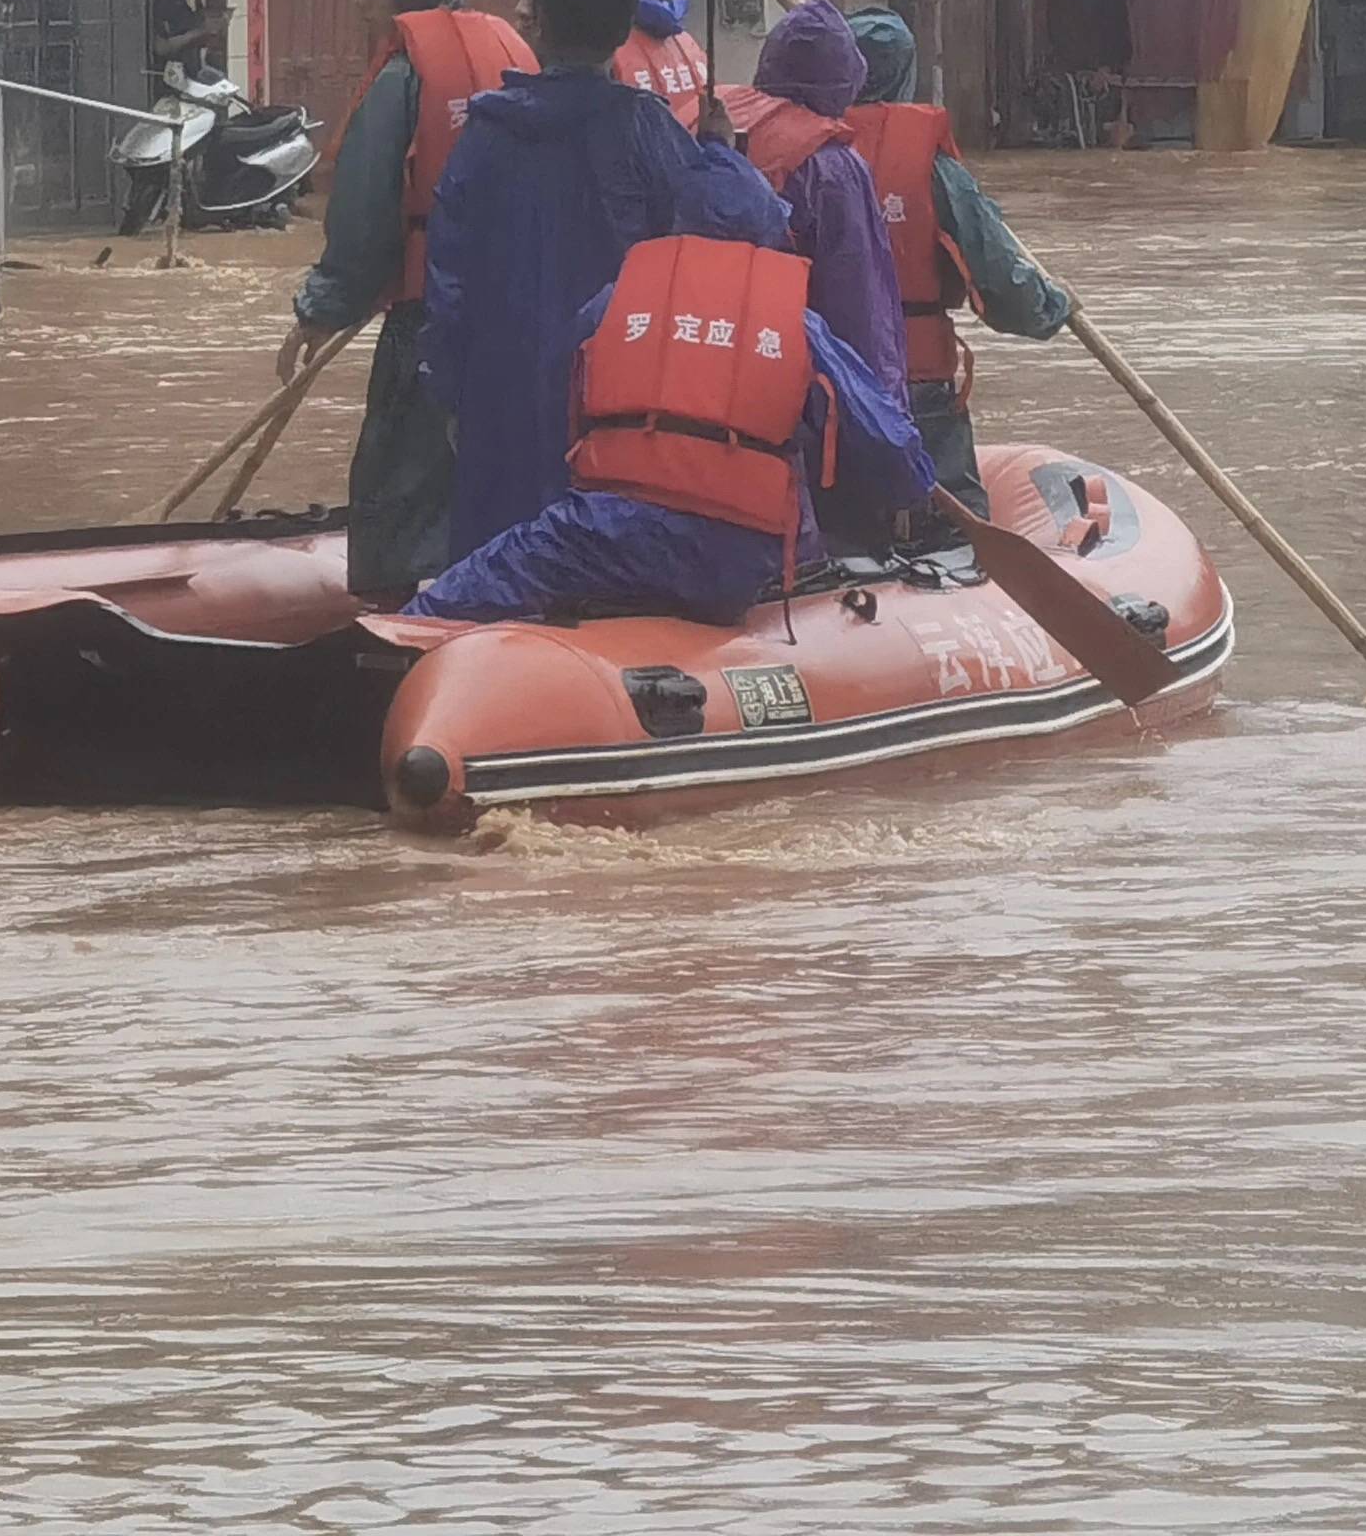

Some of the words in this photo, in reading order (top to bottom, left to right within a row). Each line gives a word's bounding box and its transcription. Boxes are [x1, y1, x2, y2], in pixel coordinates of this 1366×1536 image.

[624, 312, 783, 360] 罗定应急
[914, 611, 1084, 695] 云浮应
